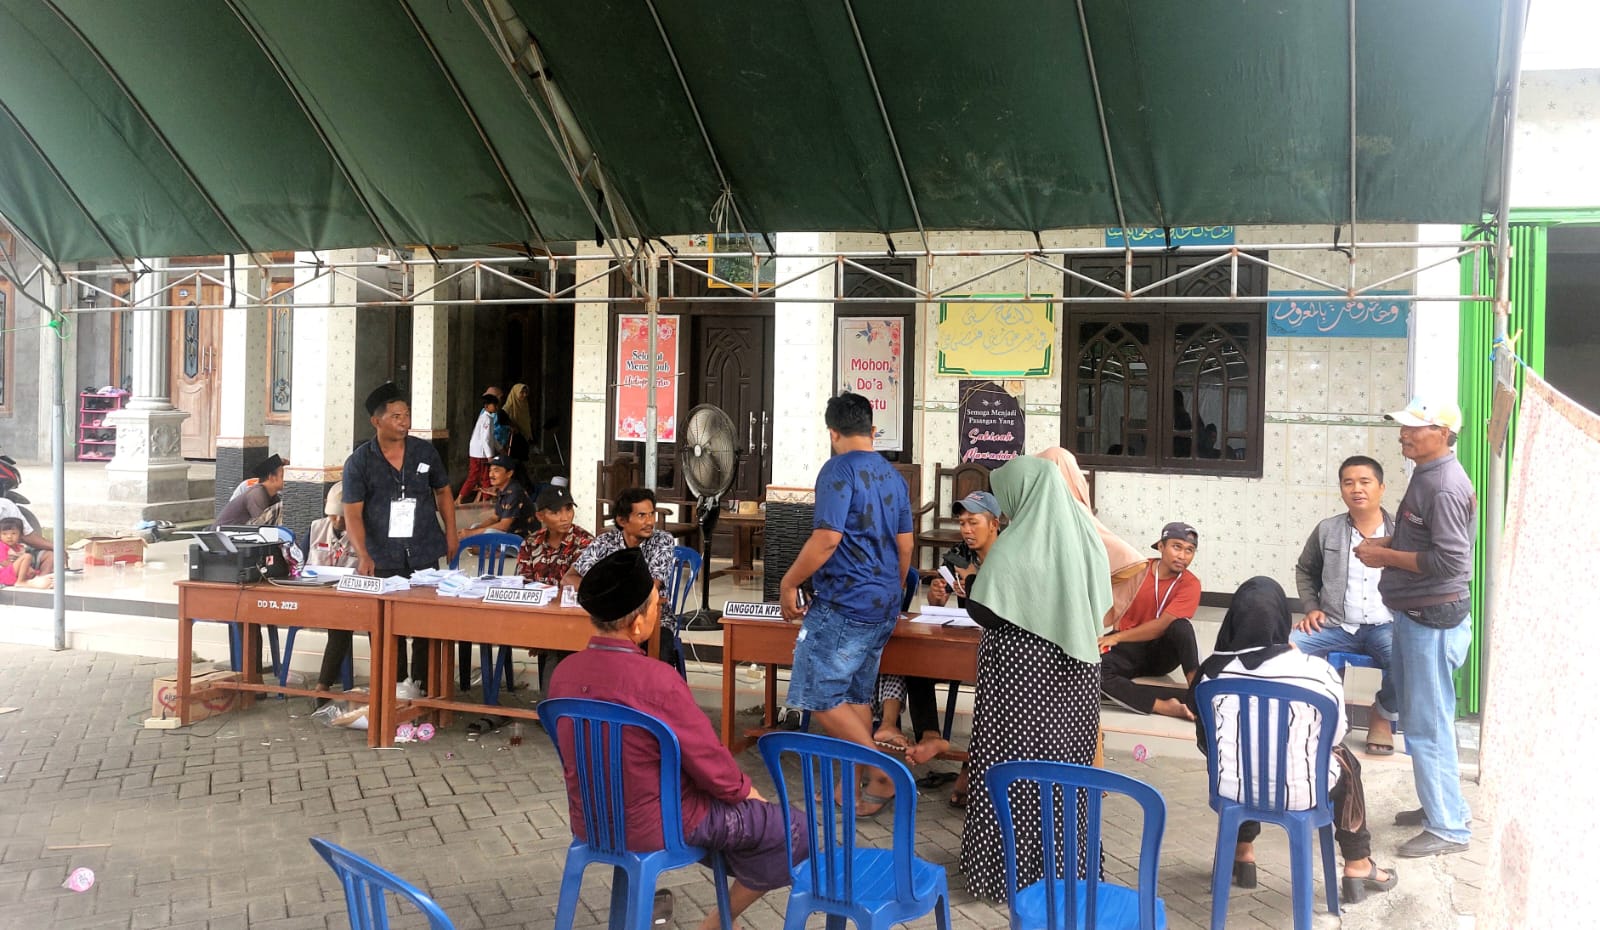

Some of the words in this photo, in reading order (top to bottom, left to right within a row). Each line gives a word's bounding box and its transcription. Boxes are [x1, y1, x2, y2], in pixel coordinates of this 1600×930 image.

[851, 358, 889, 371] Mohon
[857, 377, 883, 390] Do'a
[869, 400, 887, 410] stu
[991, 409, 1017, 418] Menjadi
[998, 417, 1015, 426] Yang
[968, 427, 1014, 444] Sakinah
[341, 577, 362, 588] KETUA
[363, 580, 379, 591] KPPS
[489, 589, 521, 600] ANGGOTA
[522, 591, 540, 601] KPPS
[728, 603, 763, 614] ANGGOTA
[765, 605, 781, 616] KPP
